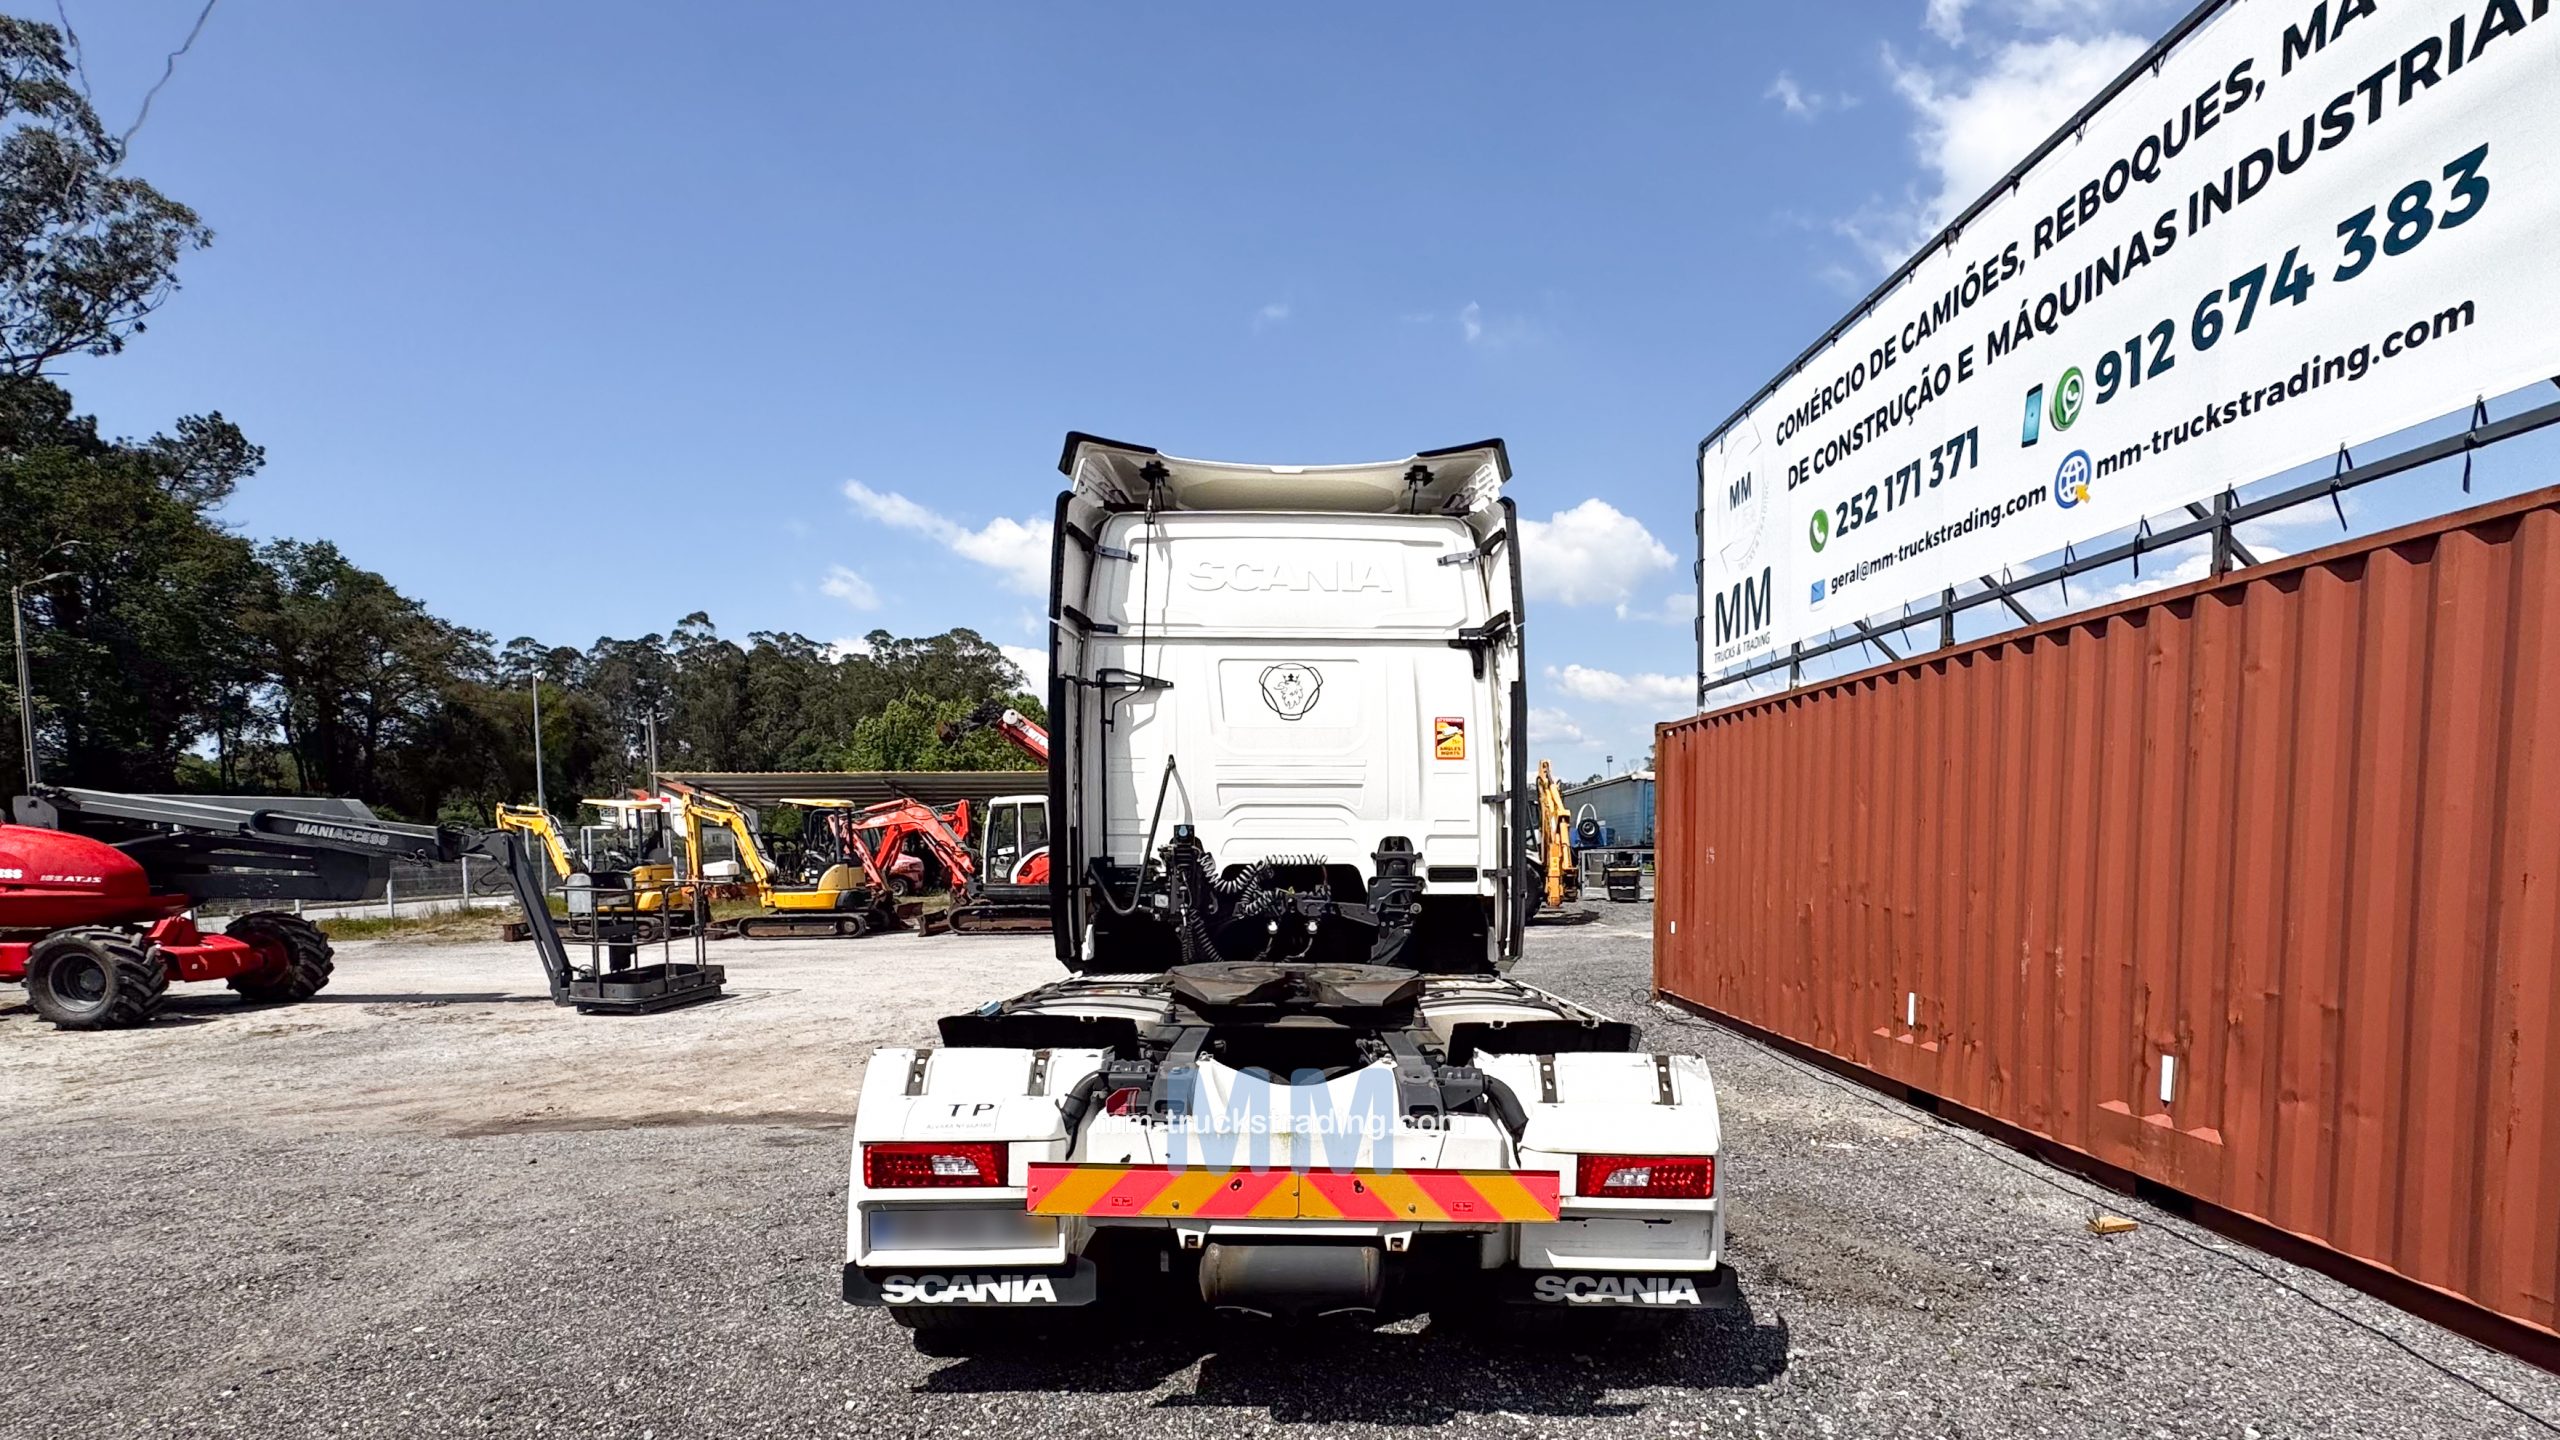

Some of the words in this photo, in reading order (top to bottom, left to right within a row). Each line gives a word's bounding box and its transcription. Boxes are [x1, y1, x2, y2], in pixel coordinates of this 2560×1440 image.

[1775, 362, 1866, 446] COMÉRCIO
[1869, 330, 1898, 376] DE
[1901, 241, 2026, 354] CAMIÕES,
[2033, 58, 2266, 259] REBOQUES,
[2095, 319, 2176, 405] 912
[2191, 245, 2315, 352] 674
[2332, 142, 2491, 282] 383
[1788, 455, 1810, 491] DE
[1813, 358, 1951, 475] CONSTRUÇÃO
[1958, 345, 1974, 384] E
[1986, 208, 2178, 365] MÁQUINAS
[2096, 299, 2475, 479] mm-truckstrading.com
[1729, 471, 1752, 511] MM
[1835, 484, 1879, 538] 252
[1884, 458, 1922, 506] 171
[1929, 426, 1979, 488] 371
[1188, 561, 1393, 593] SCANIA
[1830, 484, 2047, 595] geral@mm-truckstrading.com
[1715, 566, 1771, 647] MM
[1714, 645, 1736, 664] TRUCKS
[1743, 631, 1771, 655] TRADING
[295, 822, 389, 846] MANIACCESS
[880, 1273, 1058, 1304] SCANIA
[1533, 1275, 1702, 1305] SCANIA
